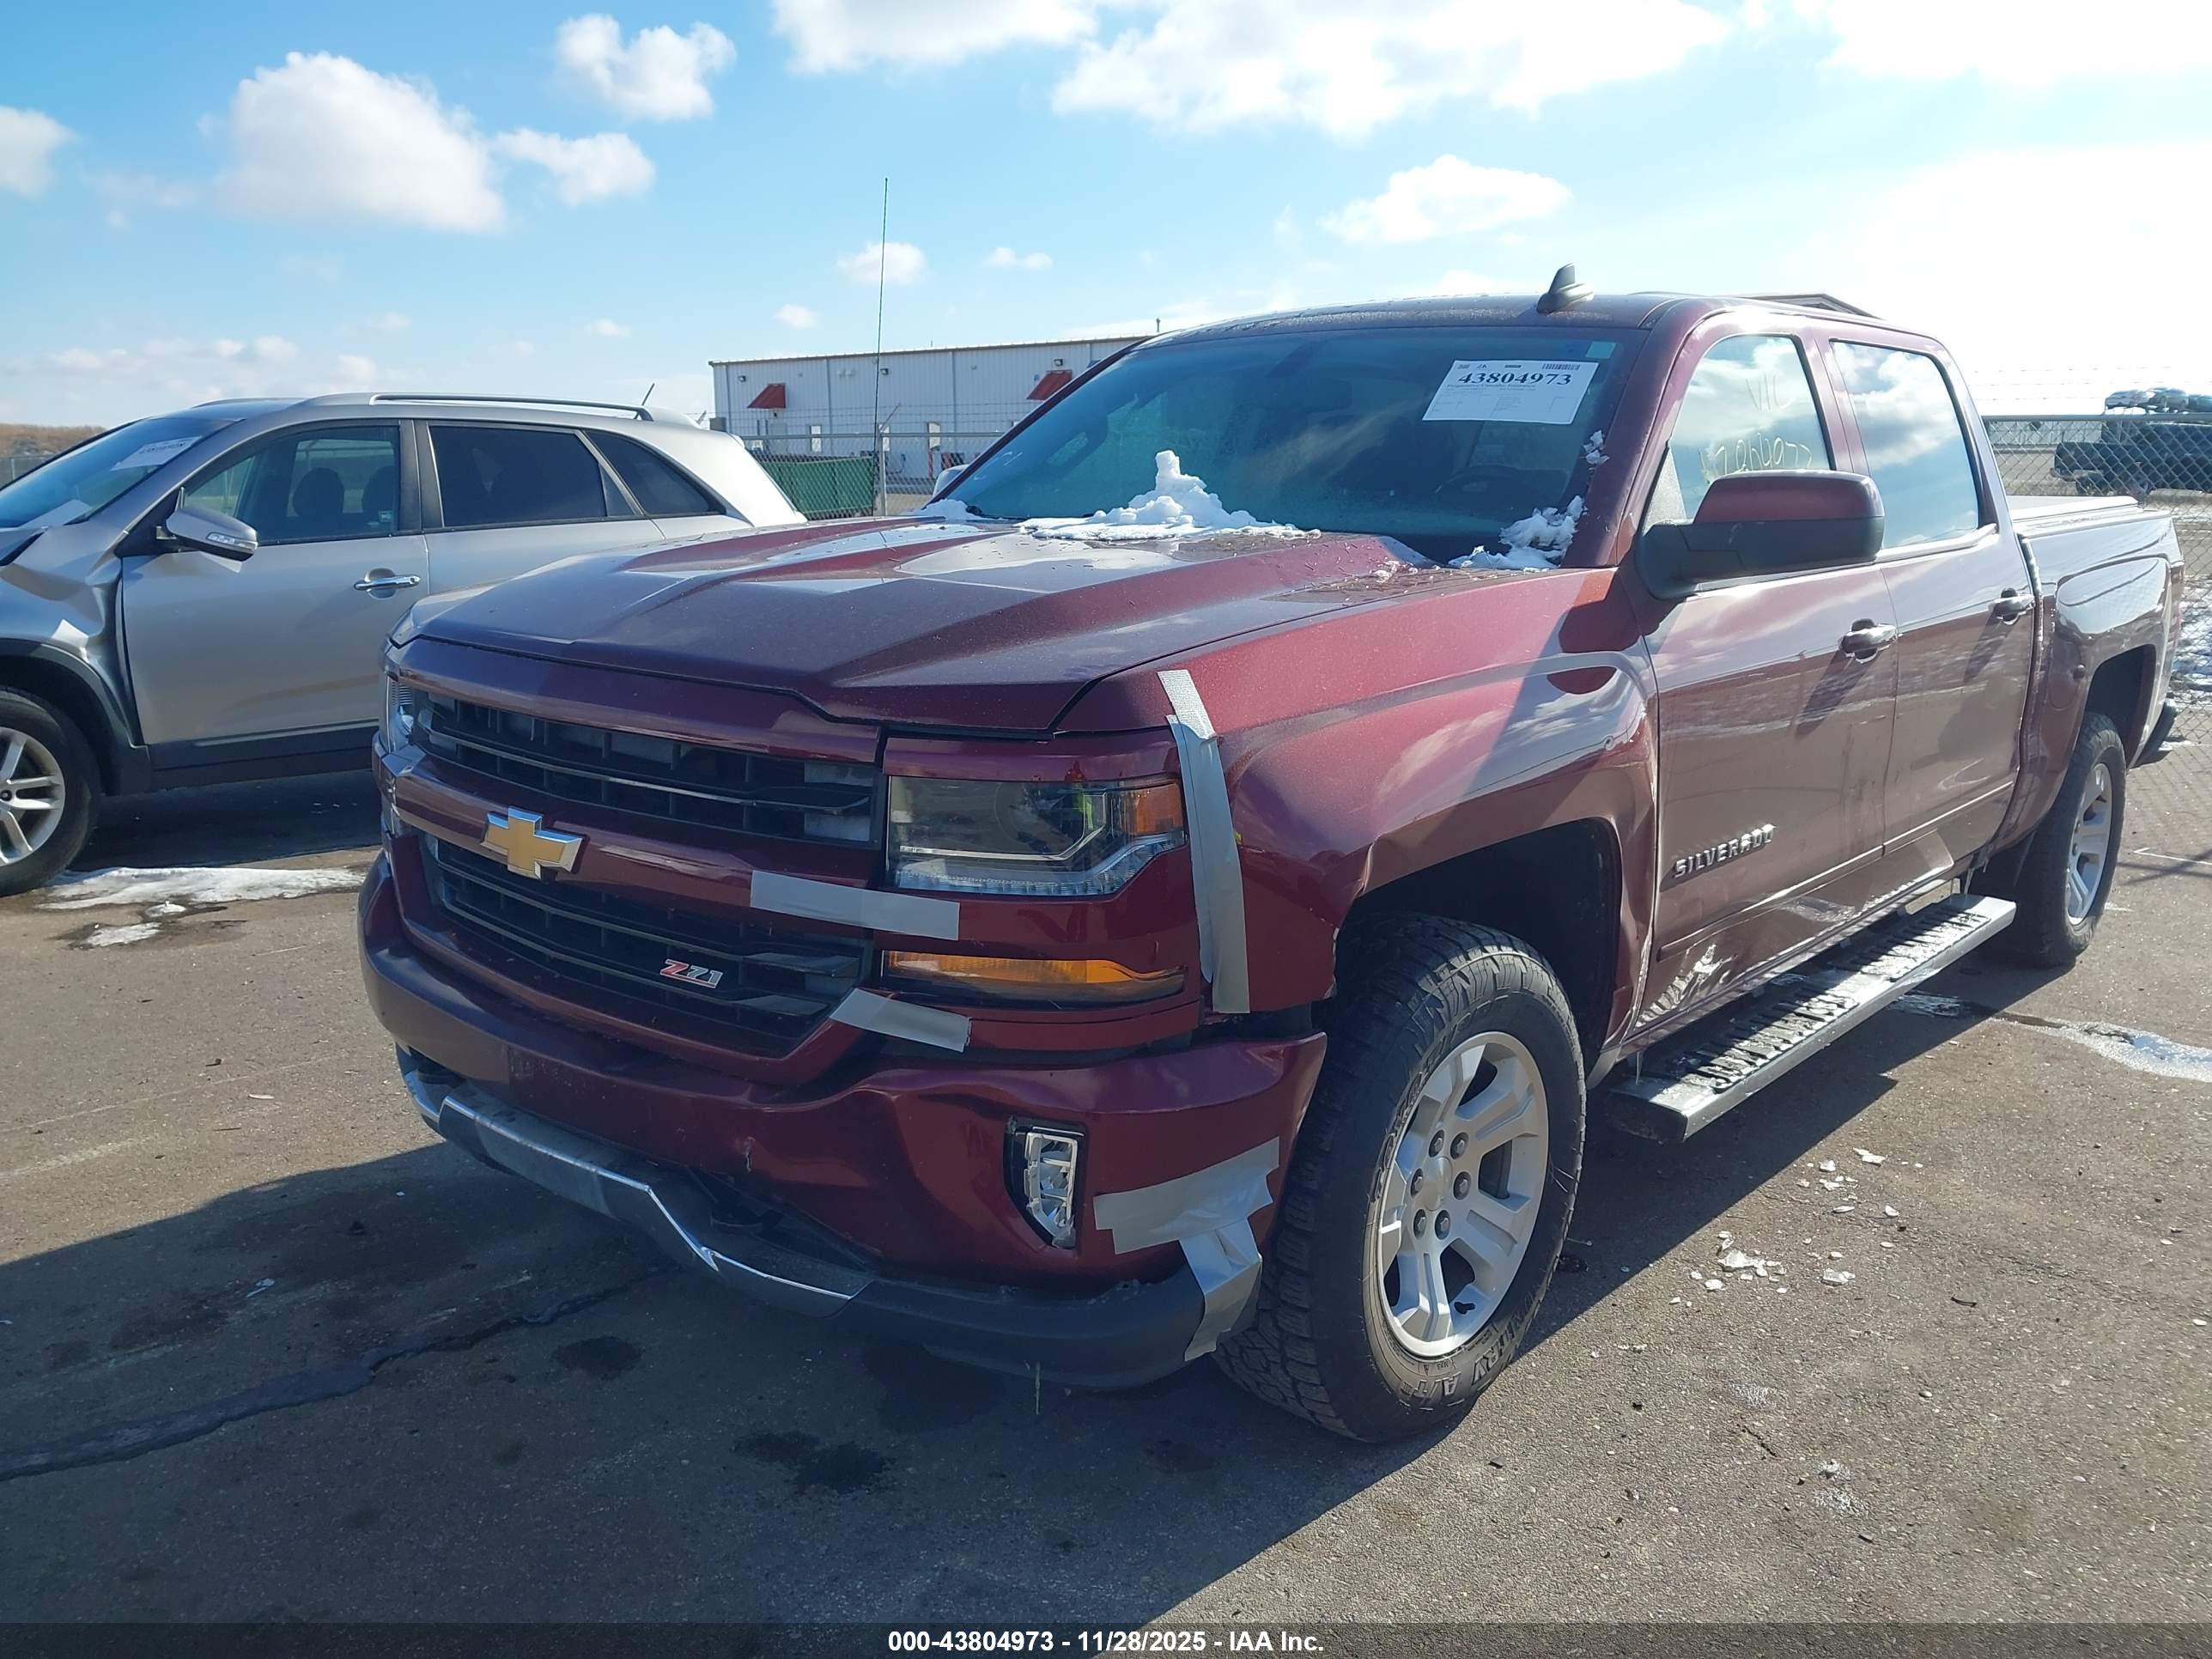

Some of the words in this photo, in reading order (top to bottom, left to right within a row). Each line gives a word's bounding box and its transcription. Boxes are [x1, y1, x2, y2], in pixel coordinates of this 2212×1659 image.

[1458, 372, 1572, 386] 43804973
[1674, 823, 1777, 878] SILVERADO
[659, 958, 724, 989] Z71
